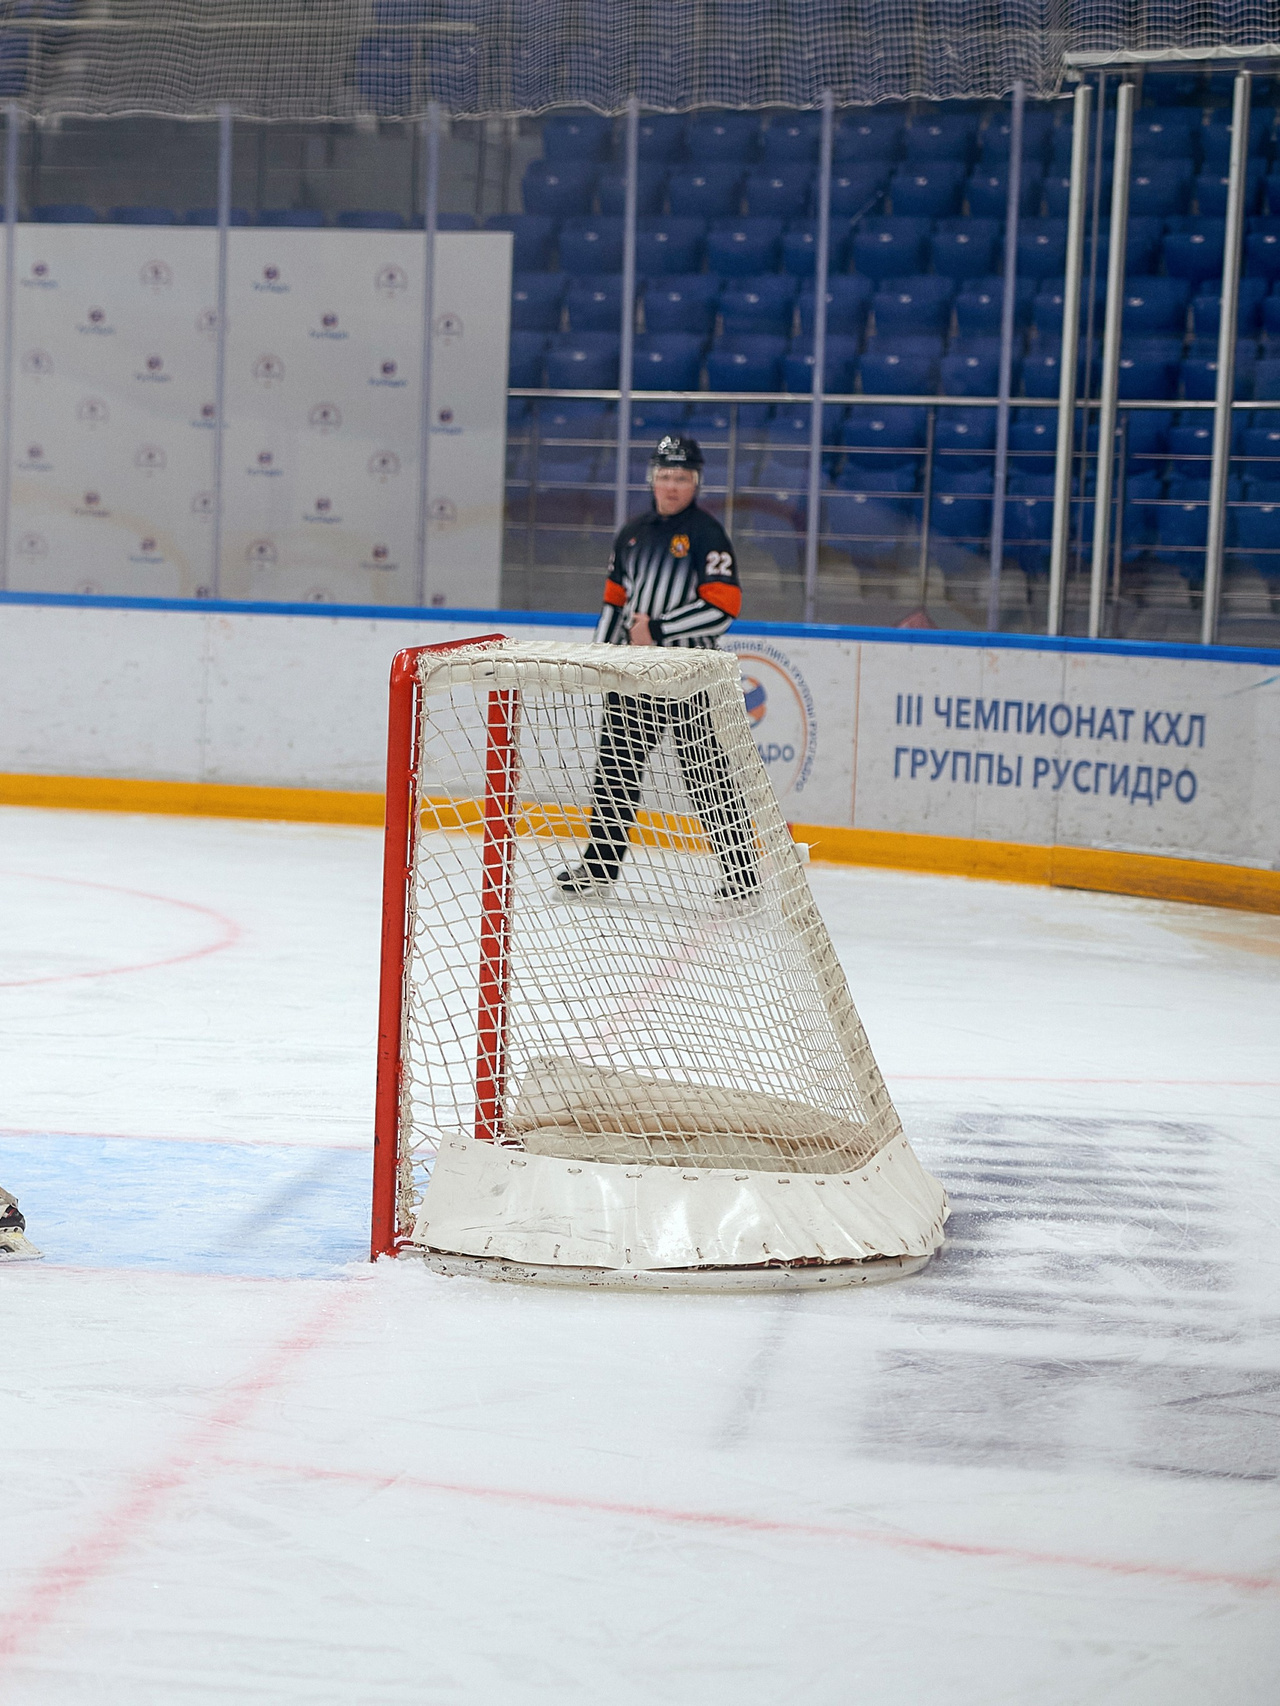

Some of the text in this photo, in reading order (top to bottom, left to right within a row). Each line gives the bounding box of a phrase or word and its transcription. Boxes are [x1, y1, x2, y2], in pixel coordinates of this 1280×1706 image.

[706, 551, 732, 576] 22
[934, 695, 1135, 743] ЧЕМПИОНАТ
[1143, 710, 1206, 748] КХЛ
[894, 746, 1198, 806] ГРУППЫ РУСГИДРО
